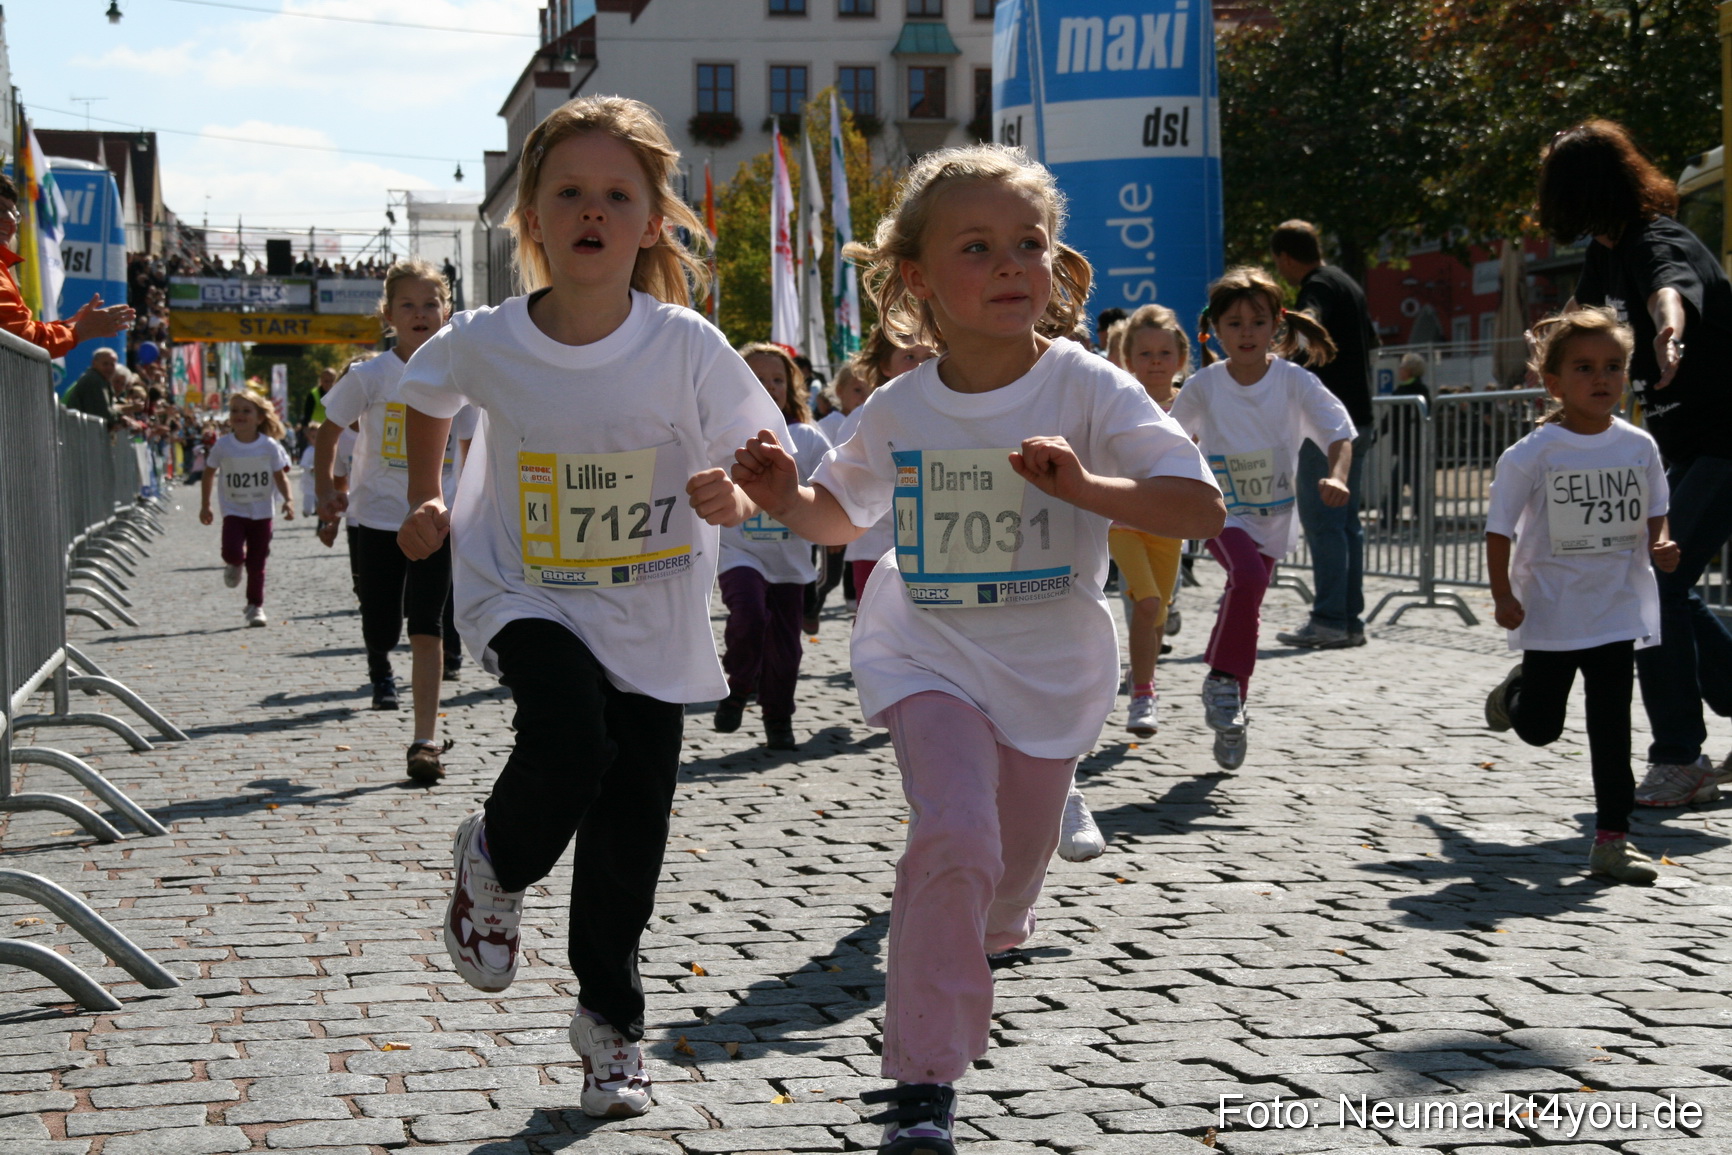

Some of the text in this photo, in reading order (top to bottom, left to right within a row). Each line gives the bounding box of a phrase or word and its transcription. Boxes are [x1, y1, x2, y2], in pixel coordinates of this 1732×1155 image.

[1056, 1, 1189, 74] maxi
[1142, 106, 1190, 147] dsl
[1106, 183, 1157, 303] sl.de
[201, 284, 284, 301] BOCK
[239, 318, 312, 335] START
[1380, 373, 1391, 389] P
[565, 464, 617, 490] Lillie
[930, 462, 993, 492] Daria
[1229, 458, 1267, 472] Chiara
[226, 471, 269, 488] 10218
[1236, 472, 1289, 496] 7074
[570, 496, 677, 543] 7127
[1580, 498, 1641, 525] 7310
[934, 508, 1050, 554] 7031
[541, 570, 586, 582] BOCK
[631, 554, 691, 575] PFLEIDERER
[911, 576, 1070, 599] BOCK PFLEIDERER
